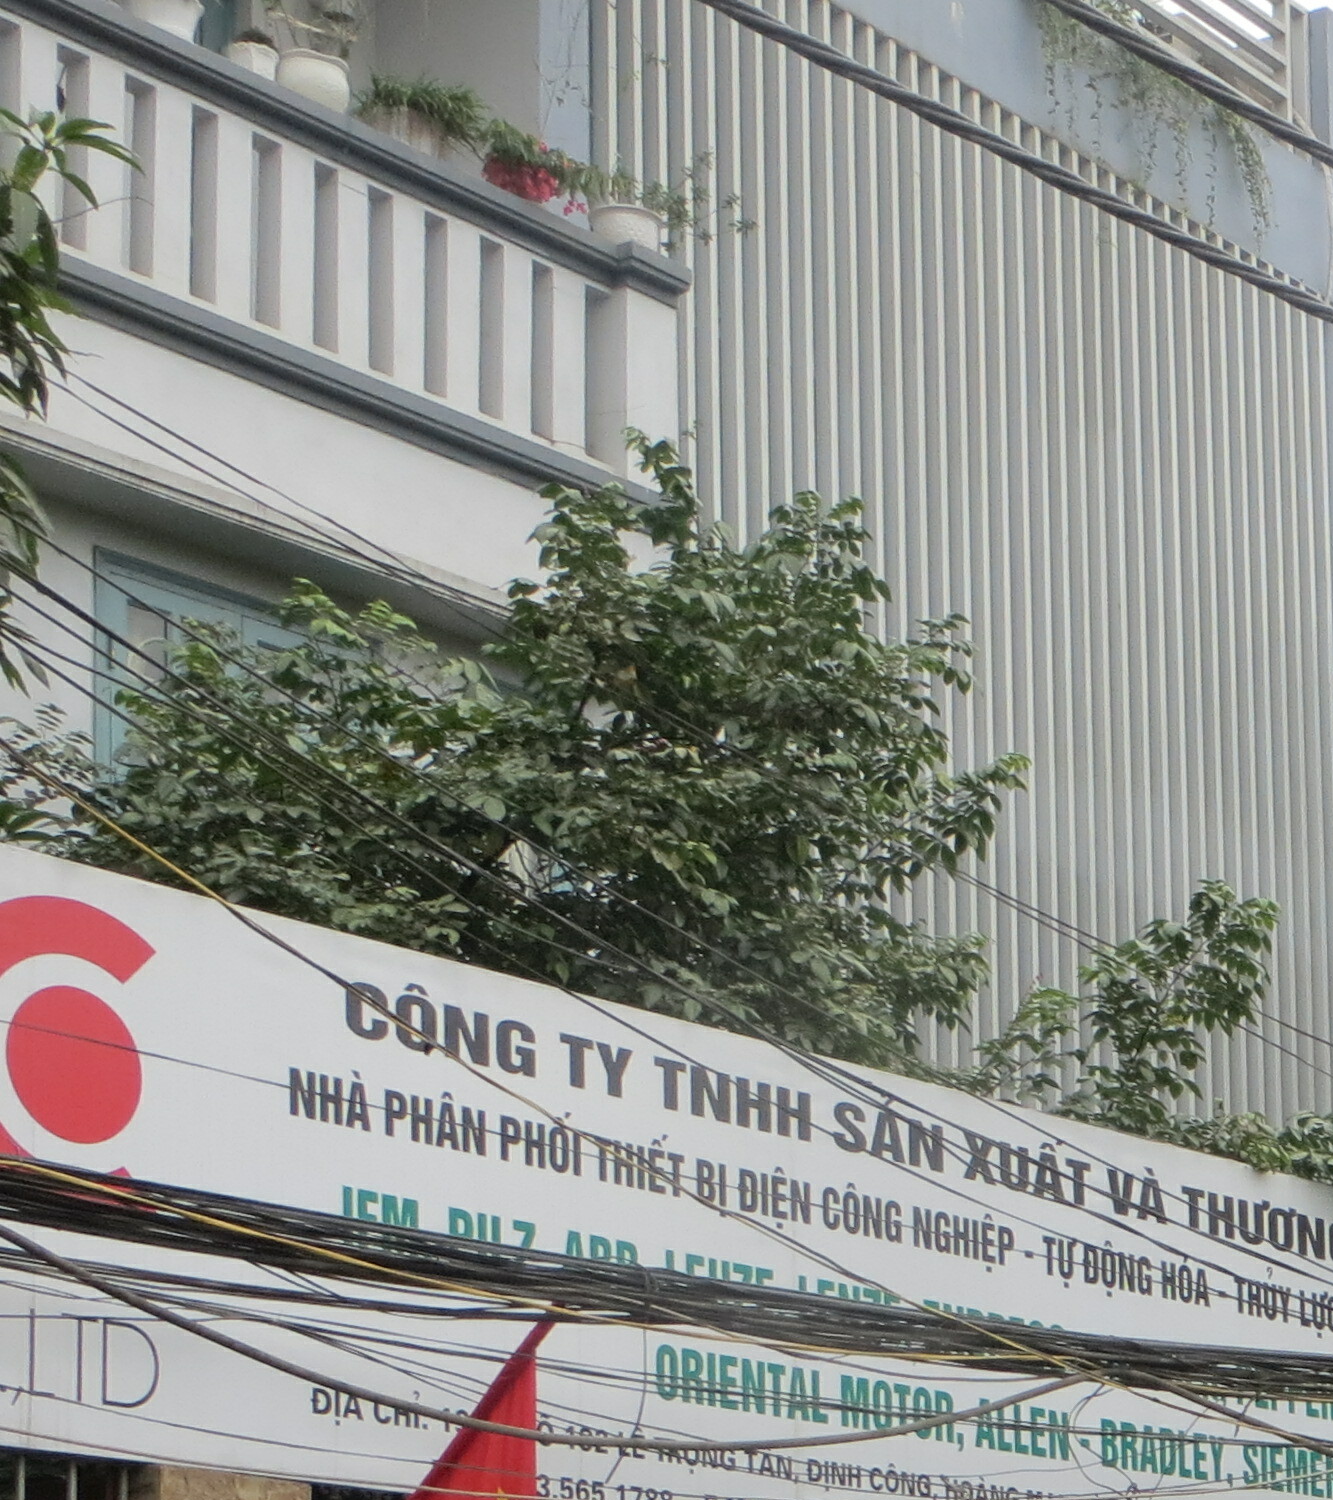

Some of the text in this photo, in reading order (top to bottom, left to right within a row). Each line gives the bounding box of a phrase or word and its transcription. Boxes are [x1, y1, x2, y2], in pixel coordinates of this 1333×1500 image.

[288, 1066, 372, 1132] NHÀ
[384, 1088, 488, 1156] PHÂN
[499, 1111, 583, 1176] PHỐI
[593, 1132, 686, 1198] THIẾT
[737, 1166, 811, 1229] ĐIỆN
[821, 1183, 903, 1245] CÔNG
[912, 1205, 1015, 1273] NGHIỆP
[1042, 1235, 1077, 1289] TỰ
[1084, 1240, 1152, 1297] ĐỘNG
[1160, 1255, 1211, 1307] HÓA
[345, 981, 537, 1079] CÔNG
[559, 1031, 633, 1099] TY
[654, 1055, 812, 1142] TNHH
[832, 1099, 944, 1173] SẢN
[1107, 1166, 1168, 1224] VÀ
[310, 1387, 364, 1426] ĐỊA
[806, 1459, 862, 1492] ĐỊNH
[655, 1344, 829, 1424] ORIENTAL
[840, 1374, 964, 1451] MOTOR,
[975, 1397, 1070, 1462] ALLEN
[1100, 1418, 1234, 1488] BRADLEY,
